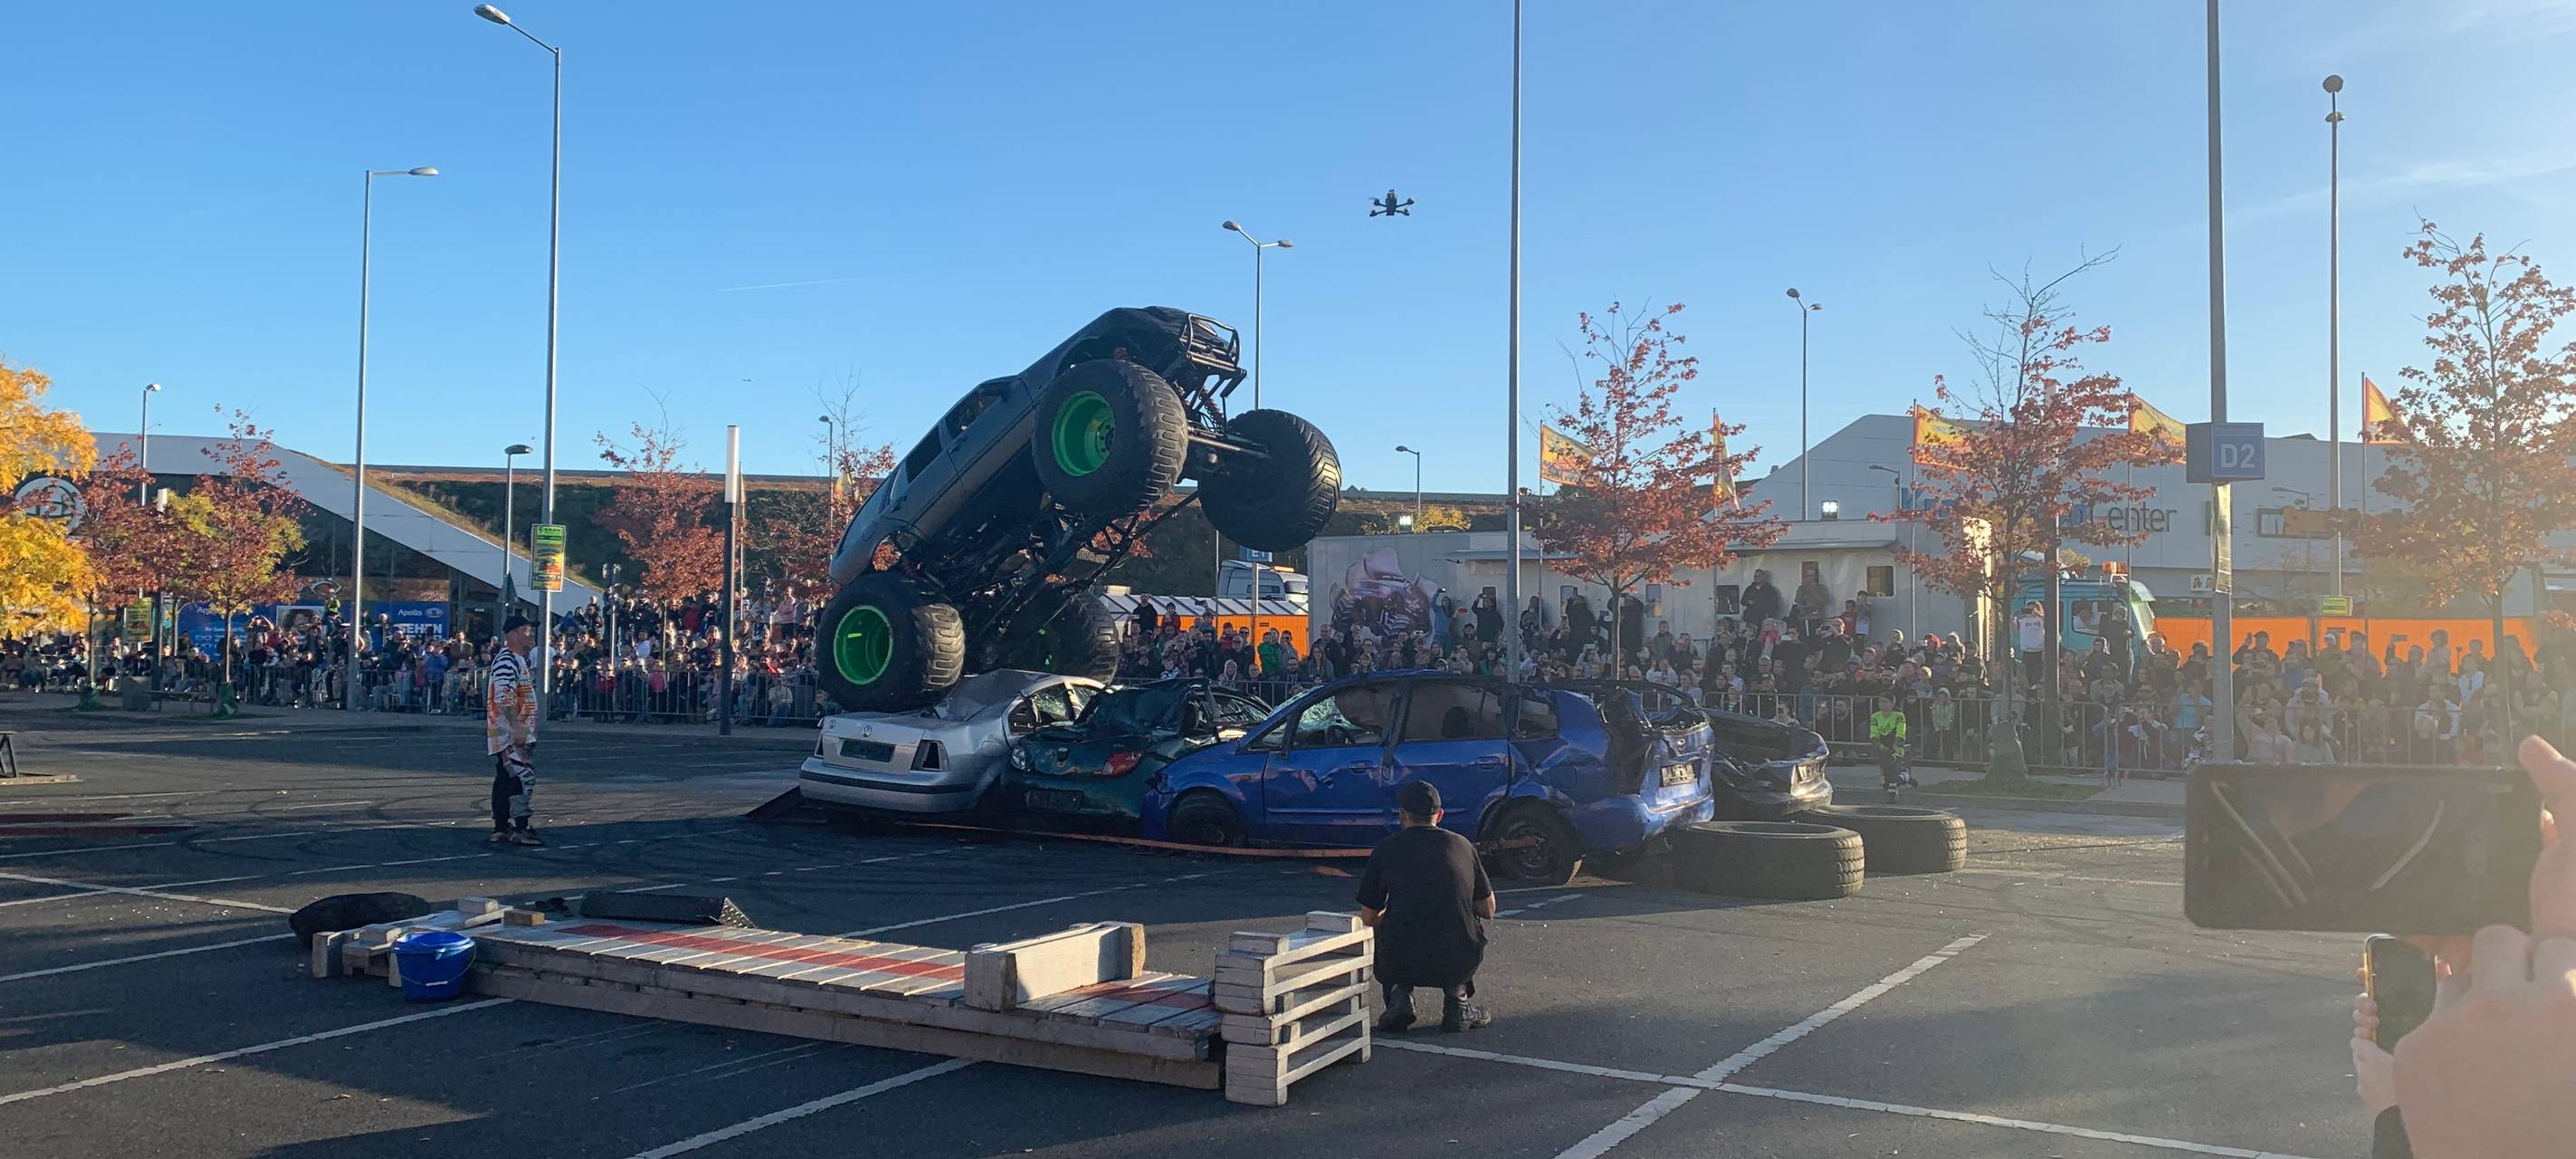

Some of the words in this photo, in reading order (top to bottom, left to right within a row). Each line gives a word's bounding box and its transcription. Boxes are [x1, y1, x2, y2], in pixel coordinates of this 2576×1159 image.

[2220, 443, 2256, 468] D2
[2102, 501, 2178, 532] enter
[398, 608, 423, 618] Apollo
